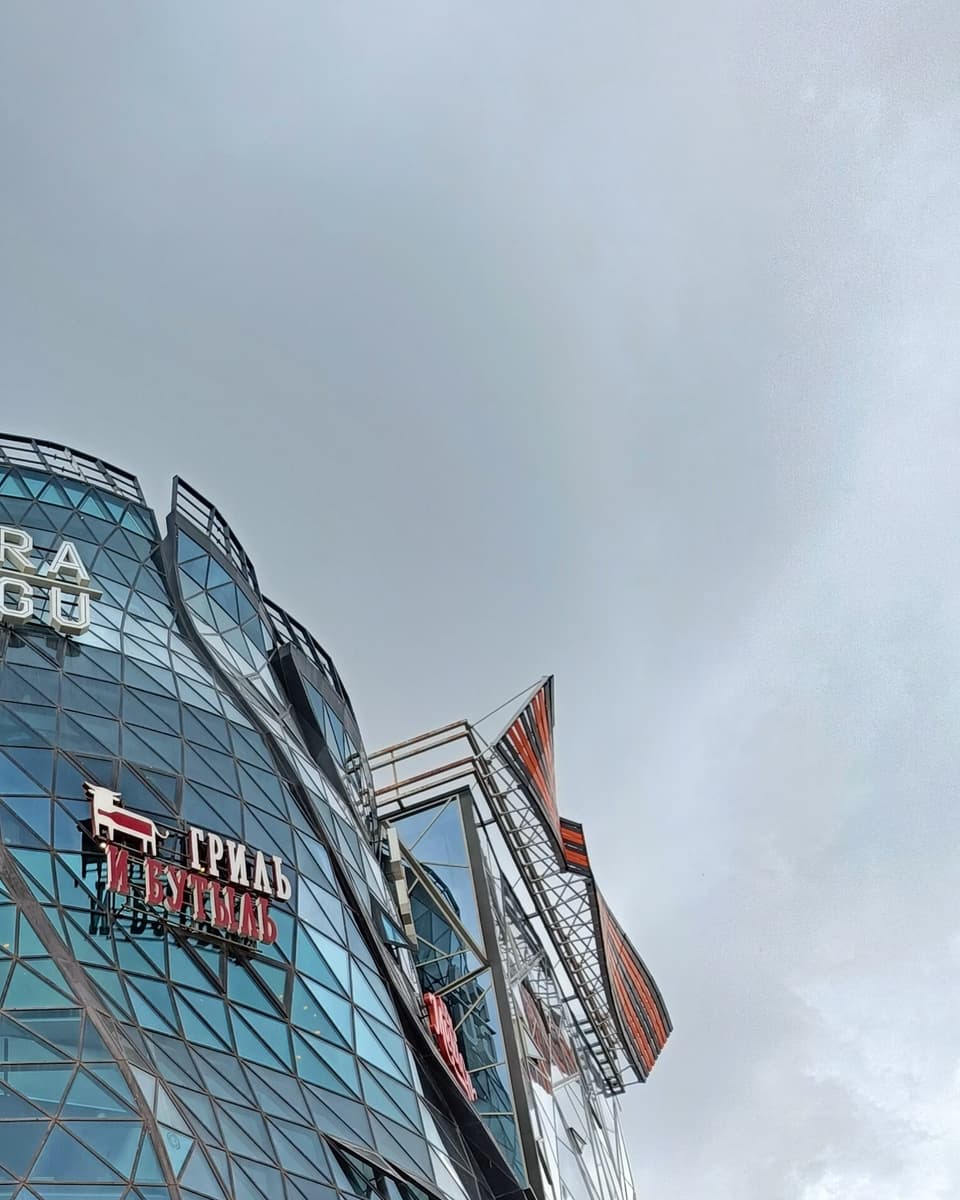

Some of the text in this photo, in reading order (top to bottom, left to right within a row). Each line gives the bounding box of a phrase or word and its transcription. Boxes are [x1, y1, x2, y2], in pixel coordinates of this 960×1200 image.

[106, 841, 279, 945] И БУТЫЛЬ
[188, 826, 292, 900] ГРИЛЬ
